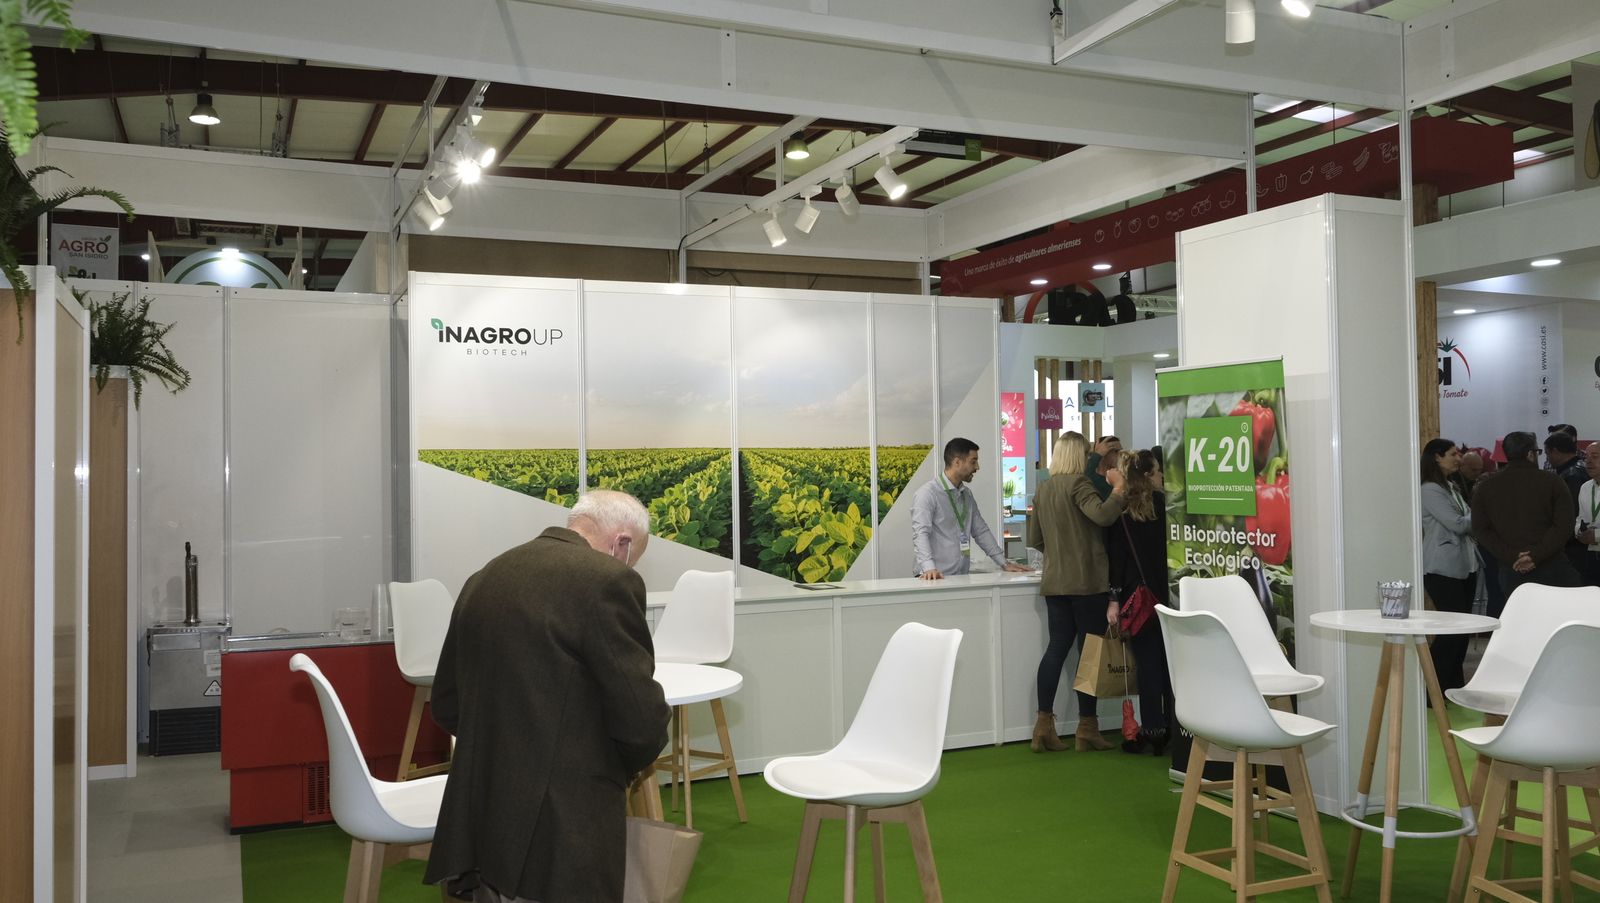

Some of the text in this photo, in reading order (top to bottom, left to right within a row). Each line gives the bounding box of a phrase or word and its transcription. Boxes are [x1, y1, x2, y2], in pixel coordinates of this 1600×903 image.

[59, 240, 109, 253] AGRO
[1015, 247, 1047, 263] agricultores
[1047, 239, 1081, 254] almerienses
[466, 348, 527, 356] BIOTECH
[1443, 388, 1468, 398] Tomate
[1188, 484, 1224, 492] BIOPROTECCIÓN
[1170, 524, 1276, 547] El Bioprotector
[1185, 548, 1260, 572] Ecológico
